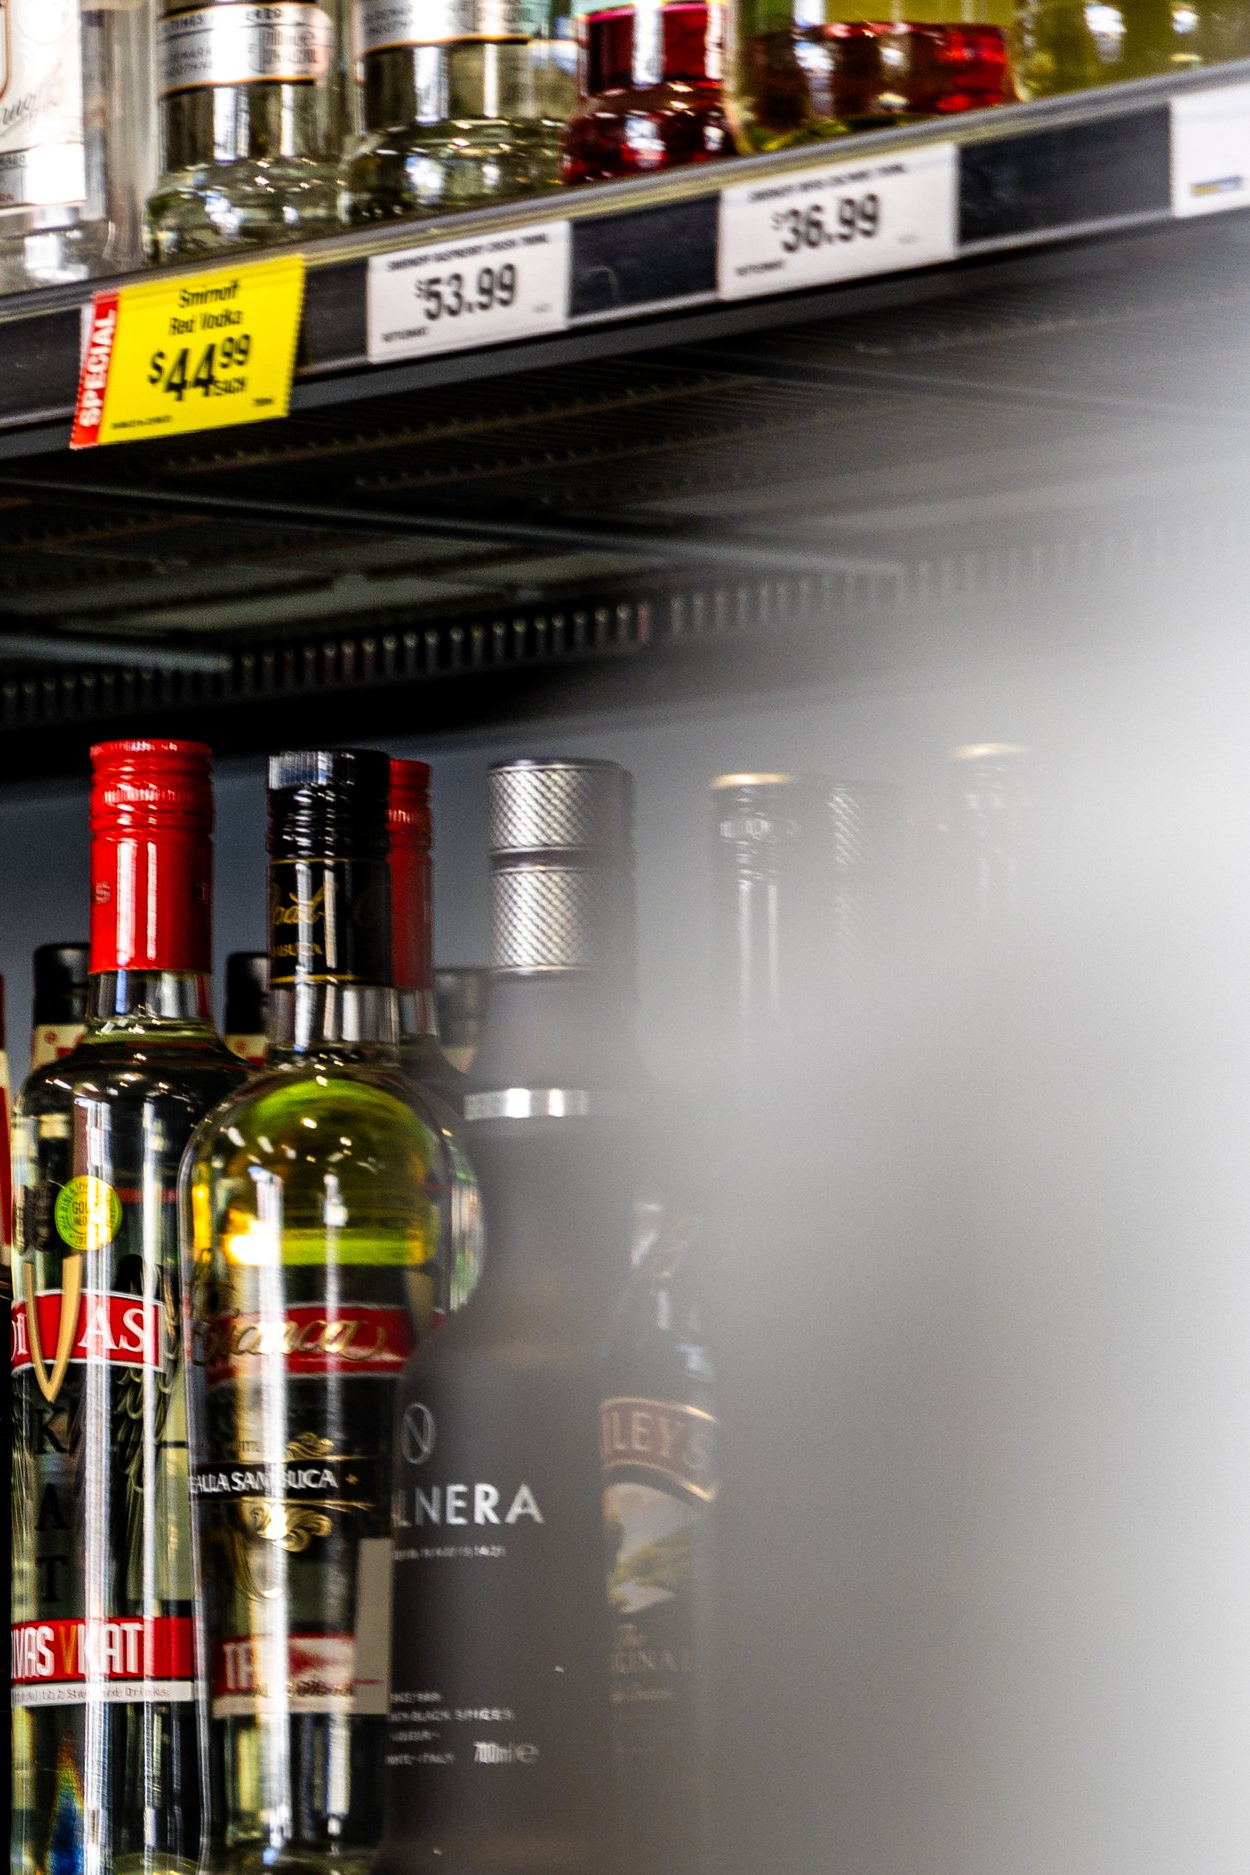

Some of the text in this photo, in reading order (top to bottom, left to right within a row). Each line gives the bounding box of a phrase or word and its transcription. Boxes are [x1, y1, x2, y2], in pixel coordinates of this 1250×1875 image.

[772, 193, 880, 254] $36.99
[178, 279, 241, 308] Smirnoff
[414, 263, 517, 320] $53.99
[169, 309, 244, 336] Red Vodka
[80, 309, 118, 428] SPECIAL
